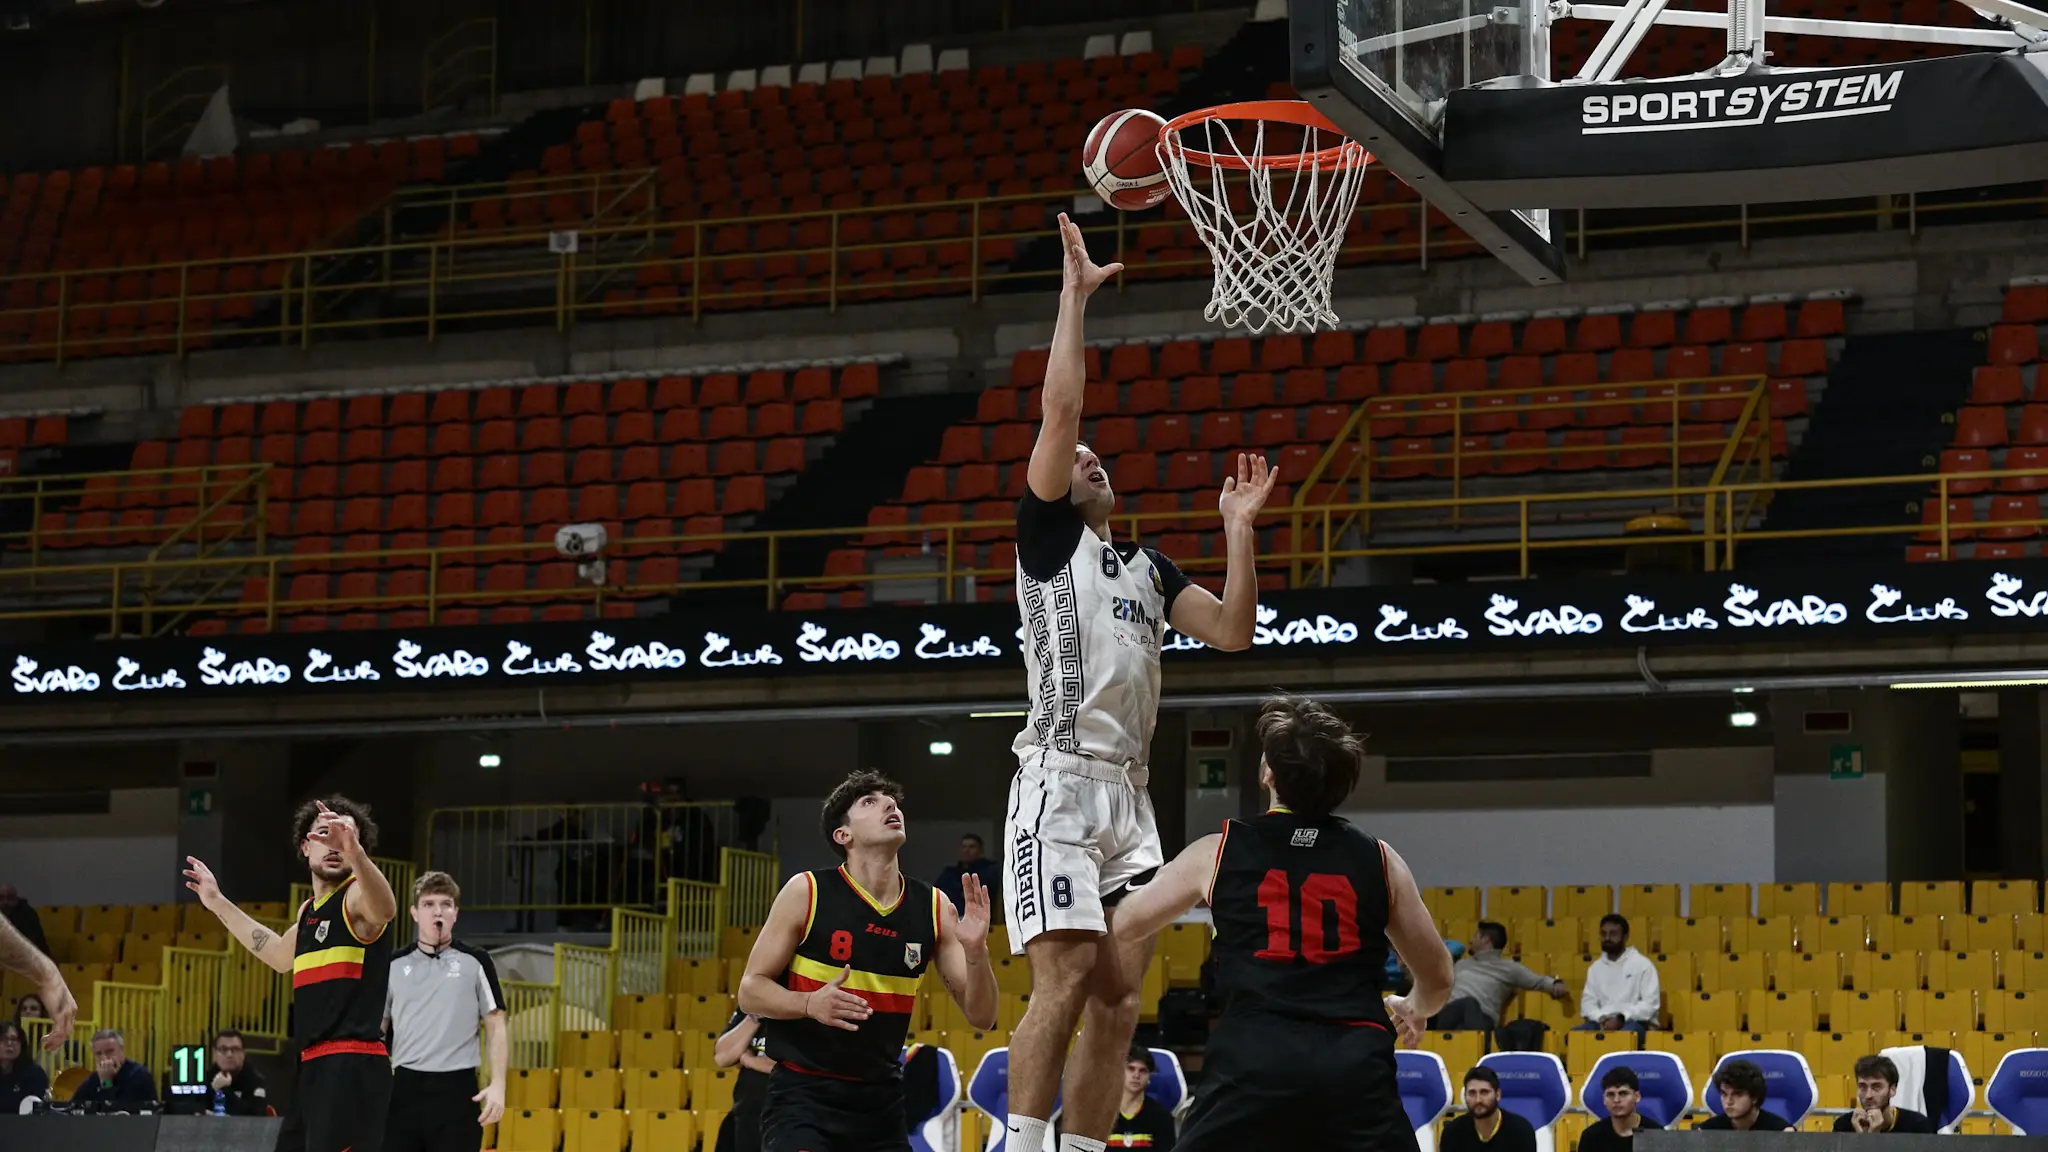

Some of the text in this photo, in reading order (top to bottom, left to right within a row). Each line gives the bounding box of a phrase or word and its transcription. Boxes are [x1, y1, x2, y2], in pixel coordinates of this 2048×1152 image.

[1100, 544, 1121, 580] 8
[1050, 874, 1075, 910] 8
[865, 922, 898, 939] Zeus
[1253, 867, 1361, 965] 10
[829, 929, 853, 961] 8
[173, 1046, 205, 1084] 11
